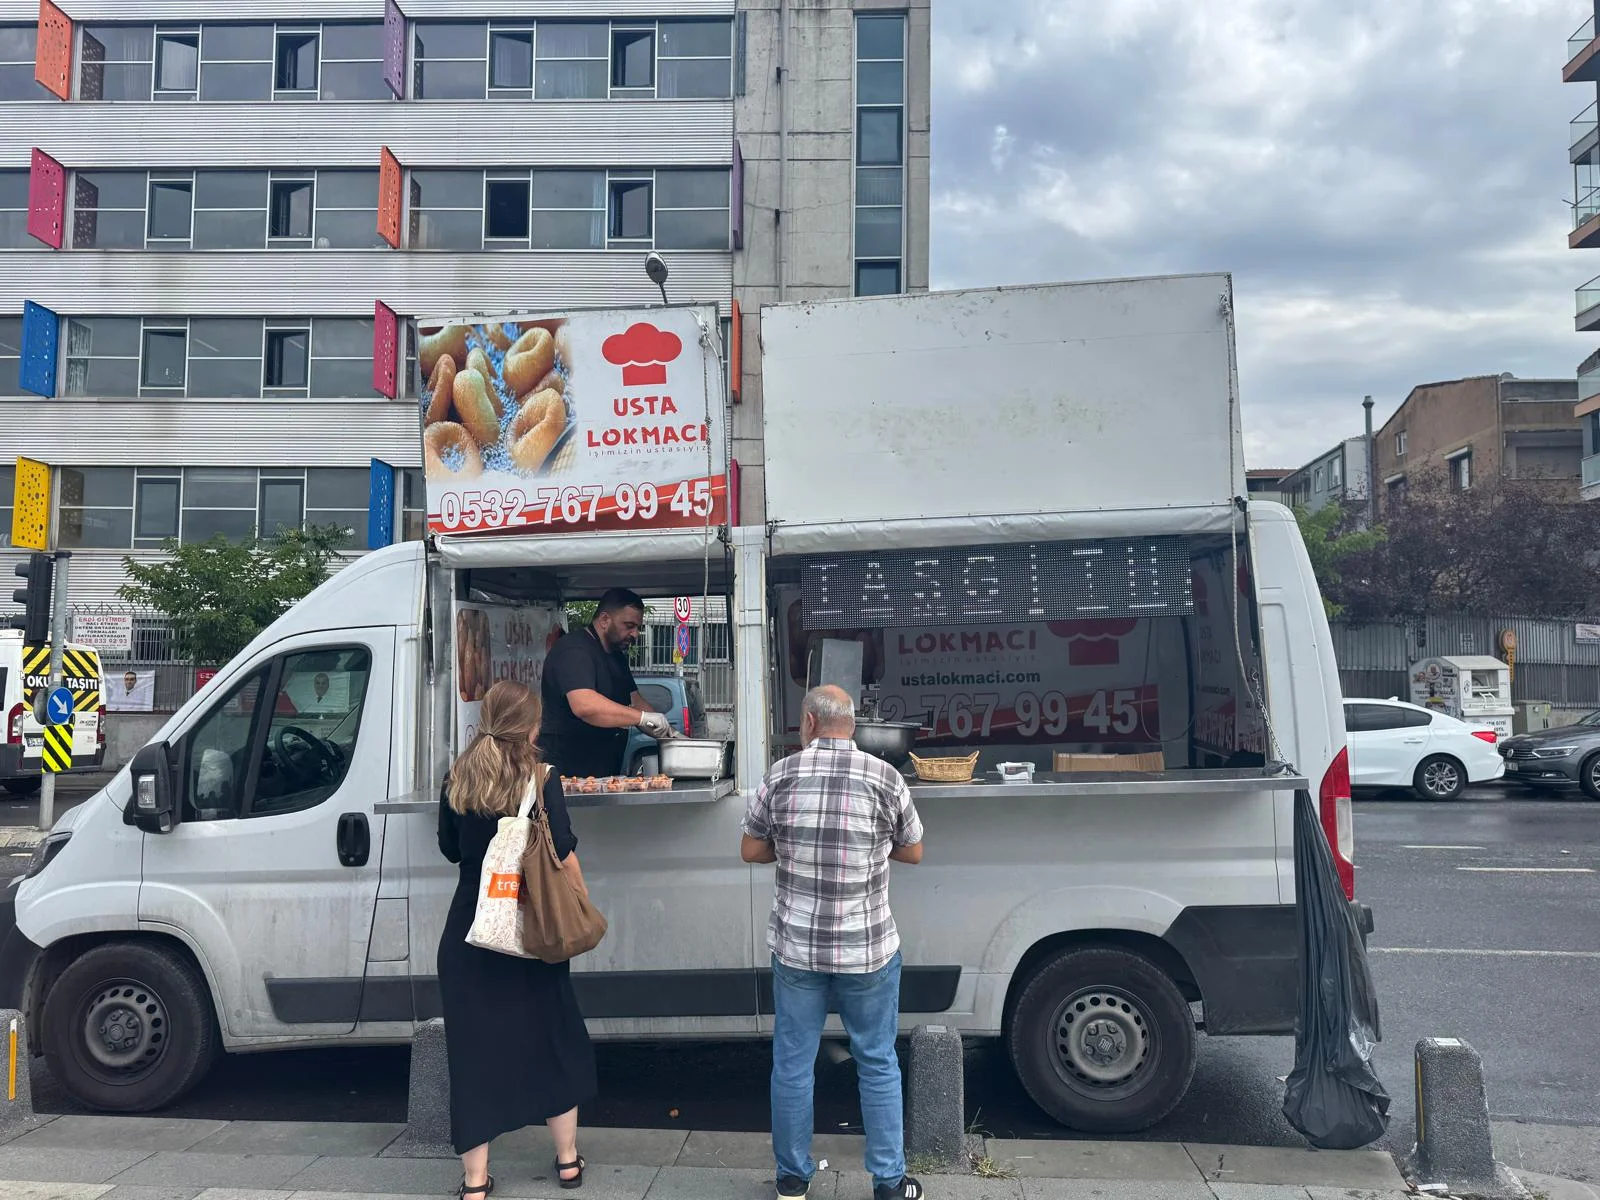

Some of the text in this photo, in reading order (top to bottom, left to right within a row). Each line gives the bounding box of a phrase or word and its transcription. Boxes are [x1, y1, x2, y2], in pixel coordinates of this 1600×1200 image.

[613, 396, 677, 416] USTA
[587, 424, 709, 447] LOKMACI
[440, 480, 714, 529] 0532 767 99 45
[677, 598, 688, 613] 30
[505, 621, 533, 646] USTA
[898, 630, 1037, 654] LOKMACI
[27, 675, 98, 691] OKU TAŞITI
[493, 660, 541, 683] LOKMAC
[901, 670, 1040, 686] ustalokmaci.com
[920, 692, 999, 738] 767
[1014, 690, 1068, 737] 99
[1083, 689, 1138, 734] 45
